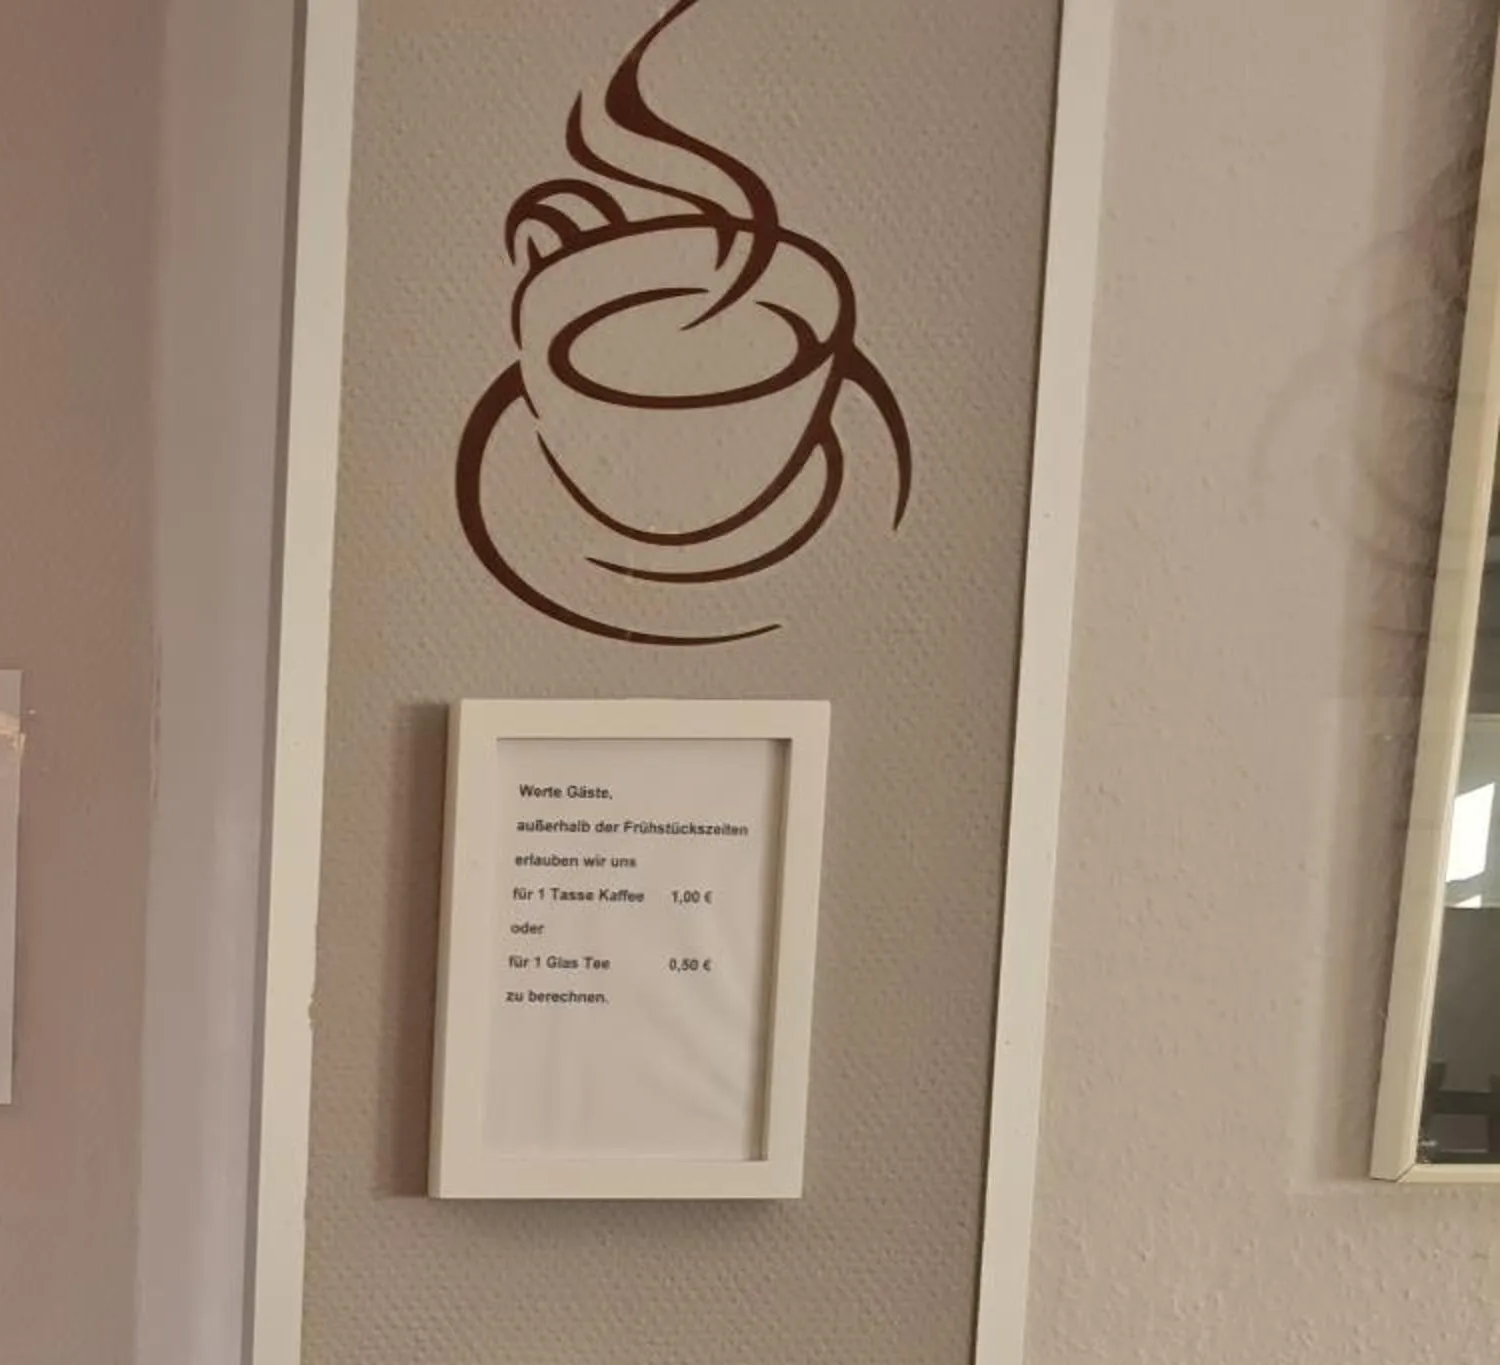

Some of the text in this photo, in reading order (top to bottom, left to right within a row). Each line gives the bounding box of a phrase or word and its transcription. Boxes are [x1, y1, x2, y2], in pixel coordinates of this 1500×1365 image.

[519, 783, 613, 800] Werte Gäste,
[516, 819, 749, 836] außerhalb der Frühstückszeiten
[514, 853, 637, 869] erlauben wir uns
[512, 886, 713, 905] für 1 Tasse Kaffee 1,00 €
[509, 921, 545, 935] oder
[508, 955, 712, 973] für 1 Glas Tee 0,50 €
[505, 989, 608, 1004] zu berechnen.
